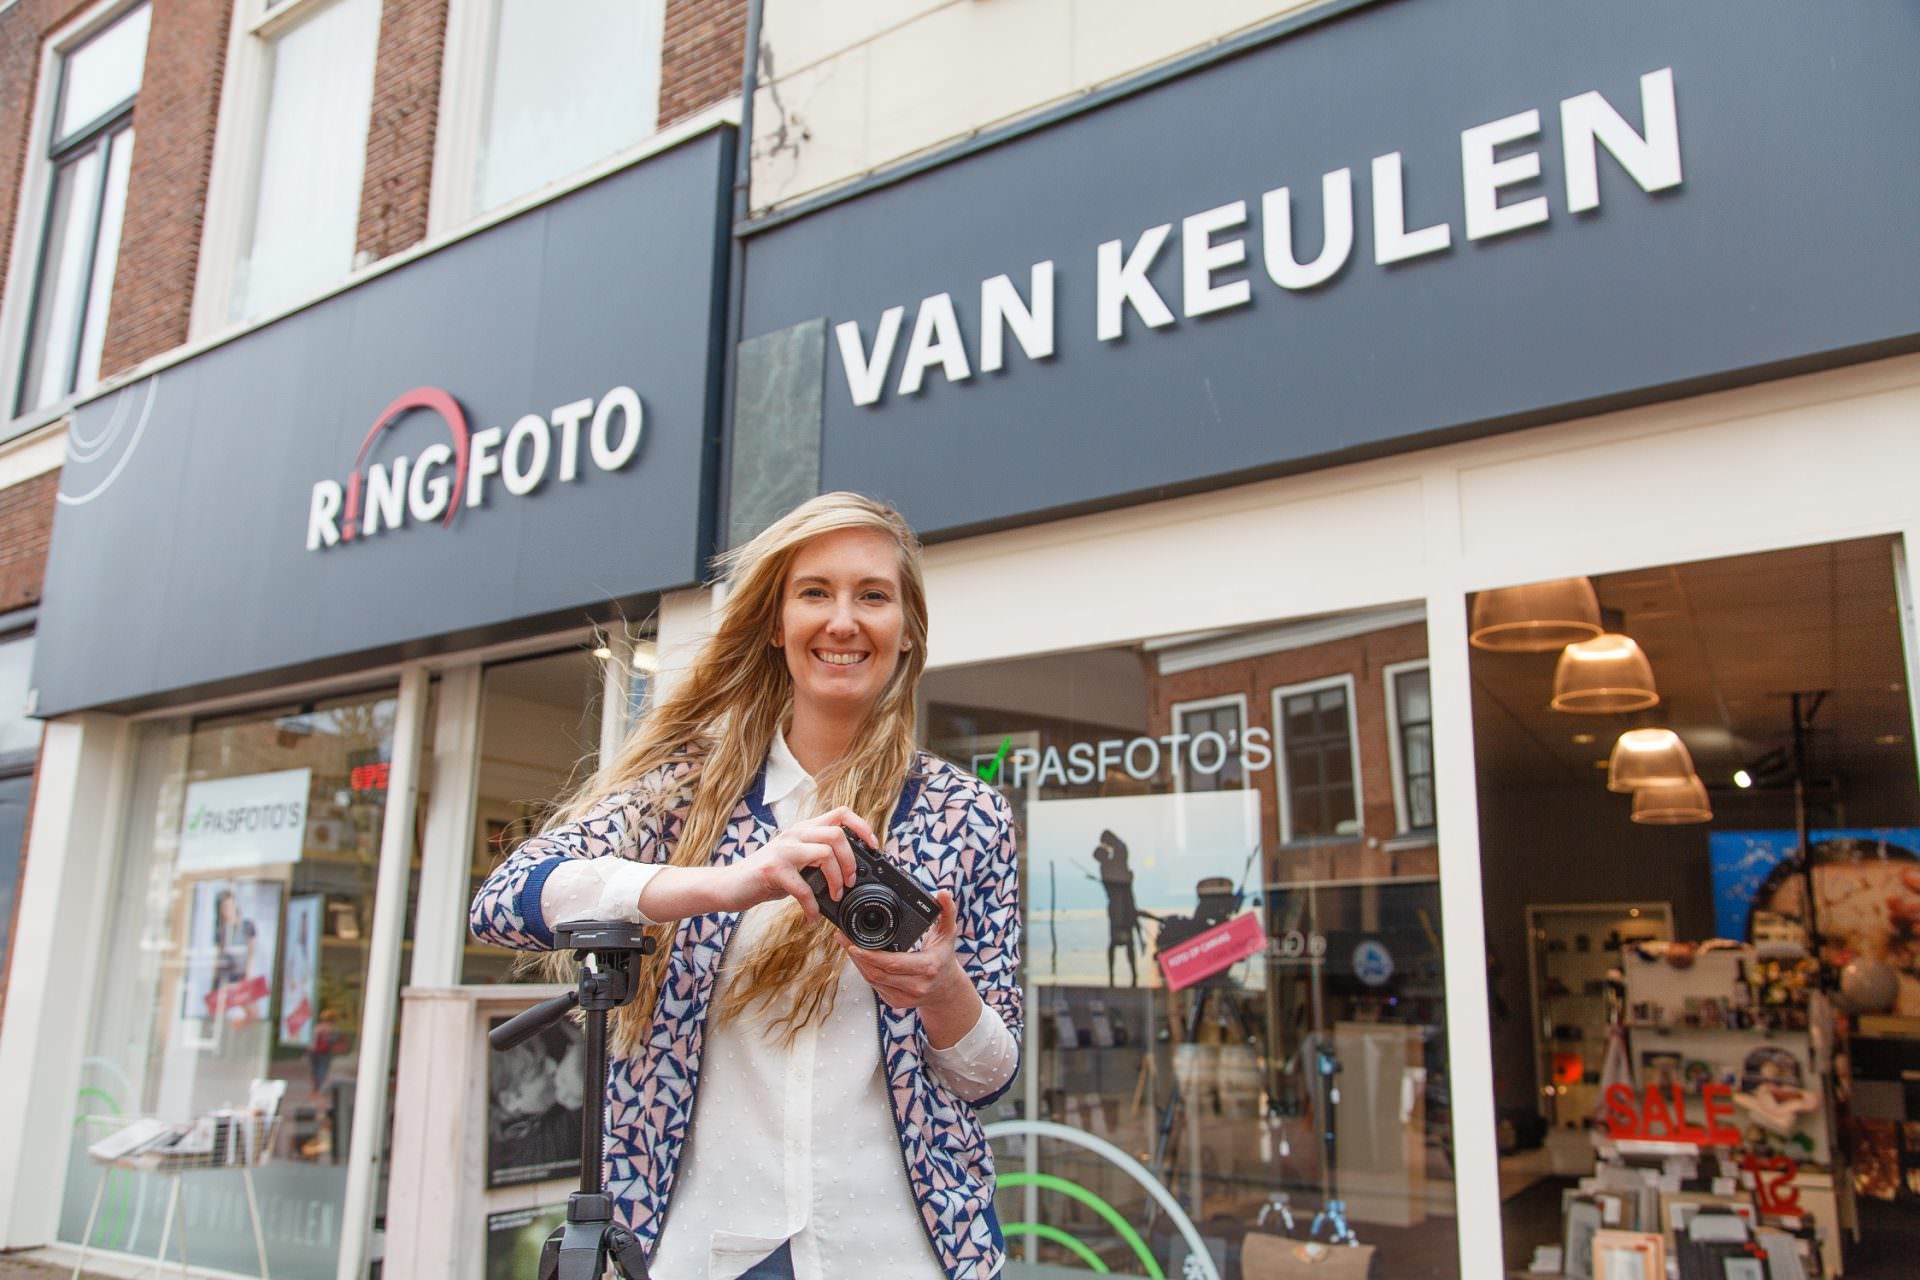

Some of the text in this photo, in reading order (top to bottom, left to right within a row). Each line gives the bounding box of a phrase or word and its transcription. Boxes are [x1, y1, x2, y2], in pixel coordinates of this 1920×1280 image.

[833, 66, 1684, 409] VAN KEULEN
[350, 762, 393, 791] OPE
[1012, 726, 1273, 789] PASFOTO'S
[1604, 1082, 1742, 1143] SALE
